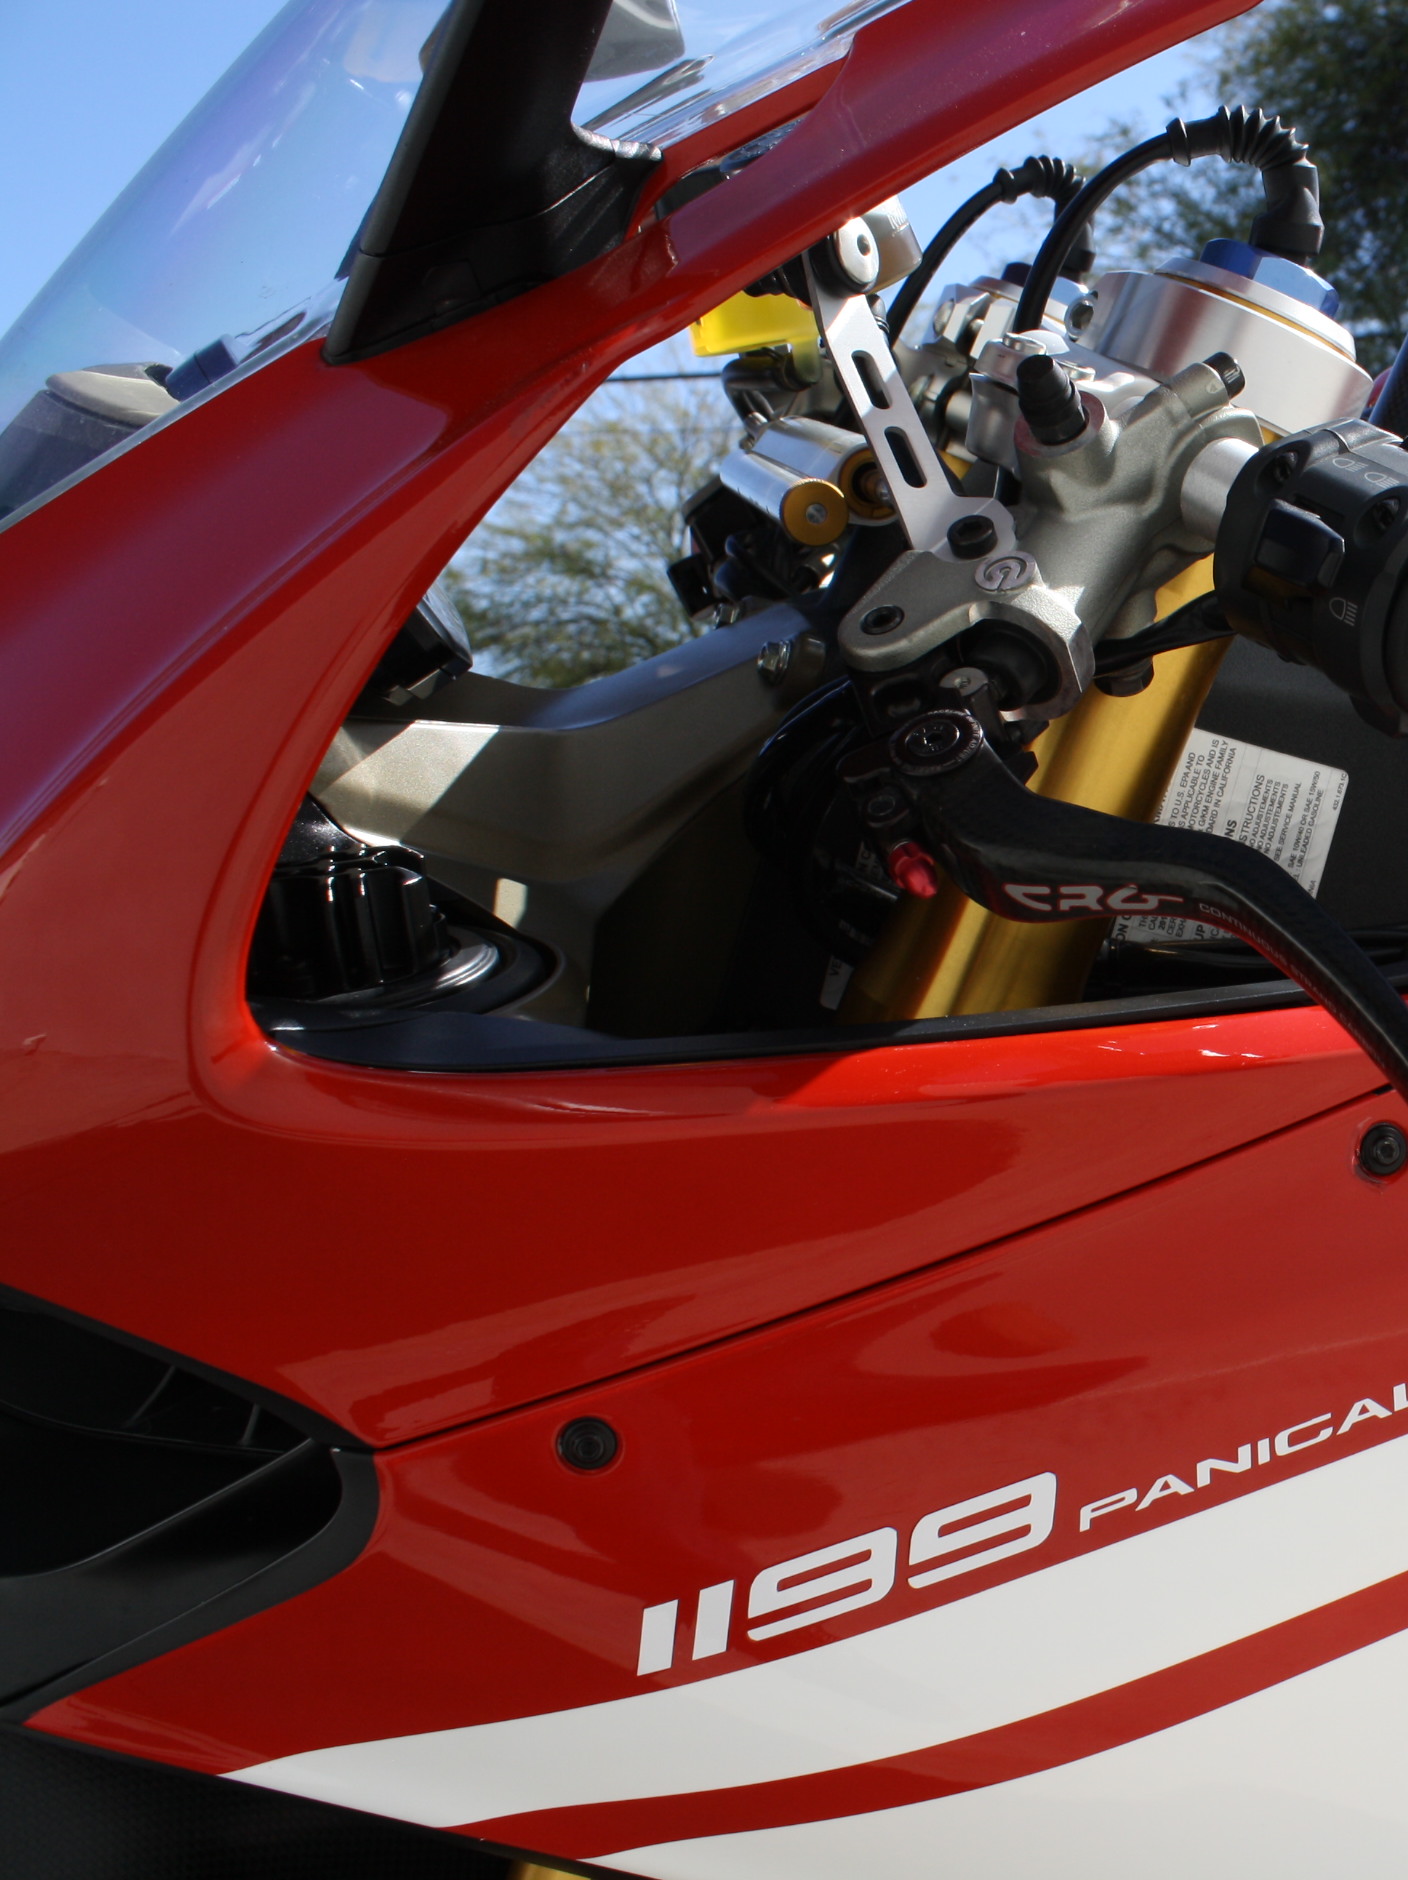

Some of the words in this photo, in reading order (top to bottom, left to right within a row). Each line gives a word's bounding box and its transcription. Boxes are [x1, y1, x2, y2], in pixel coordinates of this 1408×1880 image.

[1210, 738, 1219, 748] IS
[1184, 751, 1196, 771] AND
[1205, 748, 1216, 768] AND
[1179, 770, 1190, 787] EPA
[1204, 771, 1219, 803] ENGINE
[1214, 739, 1229, 770] FAMILY
[1216, 746, 1237, 797] CALIFORNIA
[1179, 767, 1201, 819] APPLICABLE
[1195, 754, 1205, 767] TO
[1213, 798, 1221, 808] IN
[1303, 797, 1312, 813] SAE
[1170, 807, 1179, 819] TO
[1272, 846, 1282, 861] SEE
[1277, 812, 1292, 845] SERVICE
[1287, 781, 1301, 812] MANUAL
[1299, 813, 1308, 825] OR
[1295, 827, 1312, 867] UNLEADED
[1307, 788, 1323, 826] GASOLINE
[1262, 842, 1271, 853] NO
[1287, 853, 1296, 868] SAE
[635, 1471, 1057, 1677] 1199
